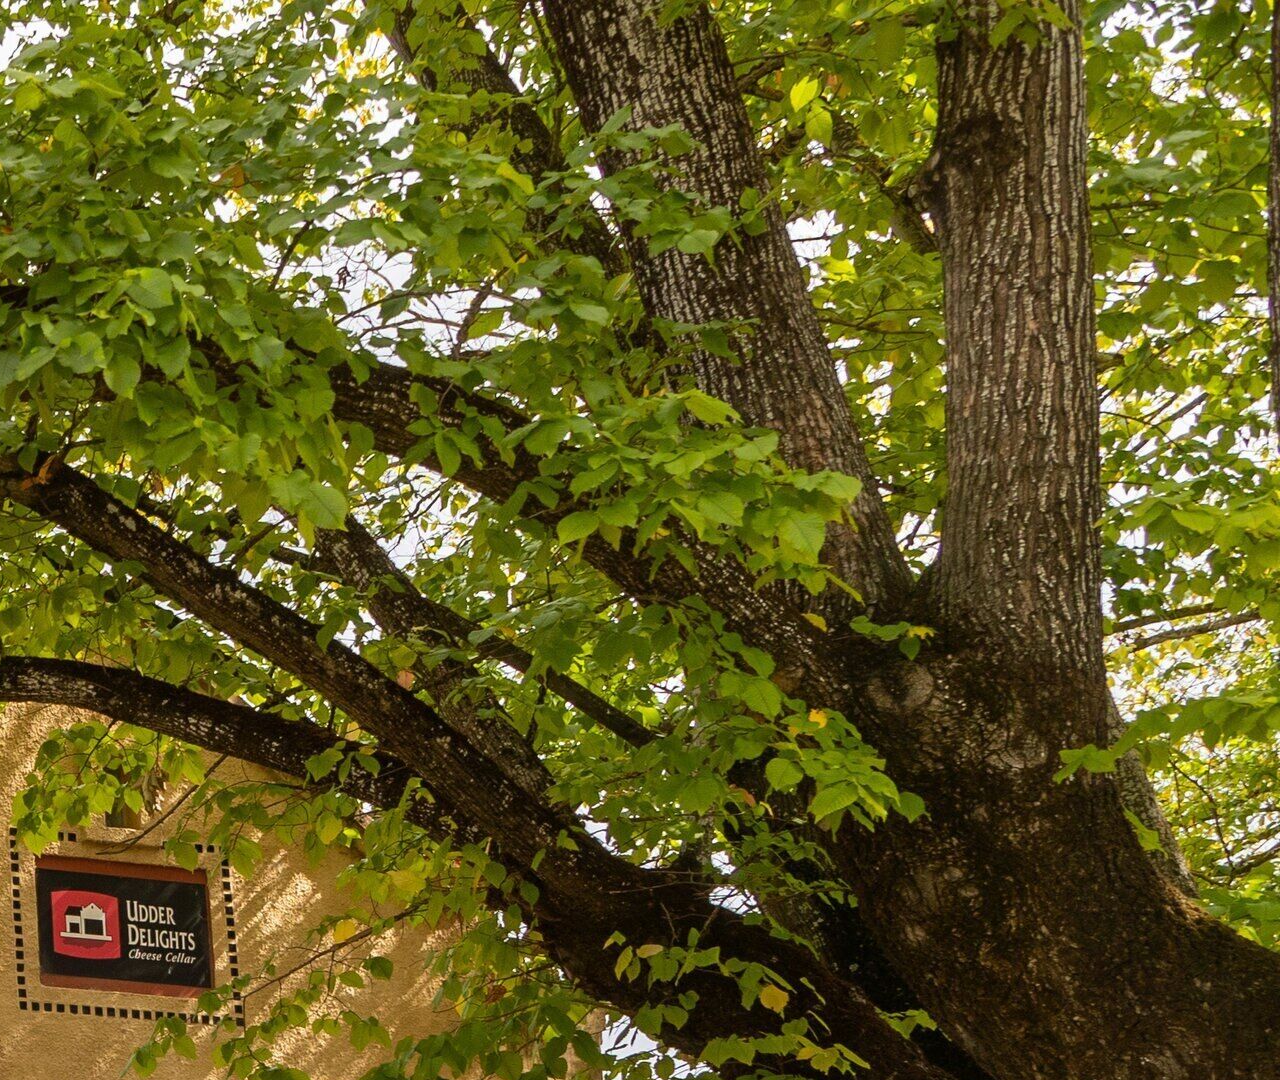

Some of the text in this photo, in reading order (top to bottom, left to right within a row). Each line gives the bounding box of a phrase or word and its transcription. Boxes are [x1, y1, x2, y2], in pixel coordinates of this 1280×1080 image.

[126, 900, 176, 925] UDDER
[127, 924, 196, 950] DELIGHTS
[128, 949, 197, 964] Cheese Cellar
